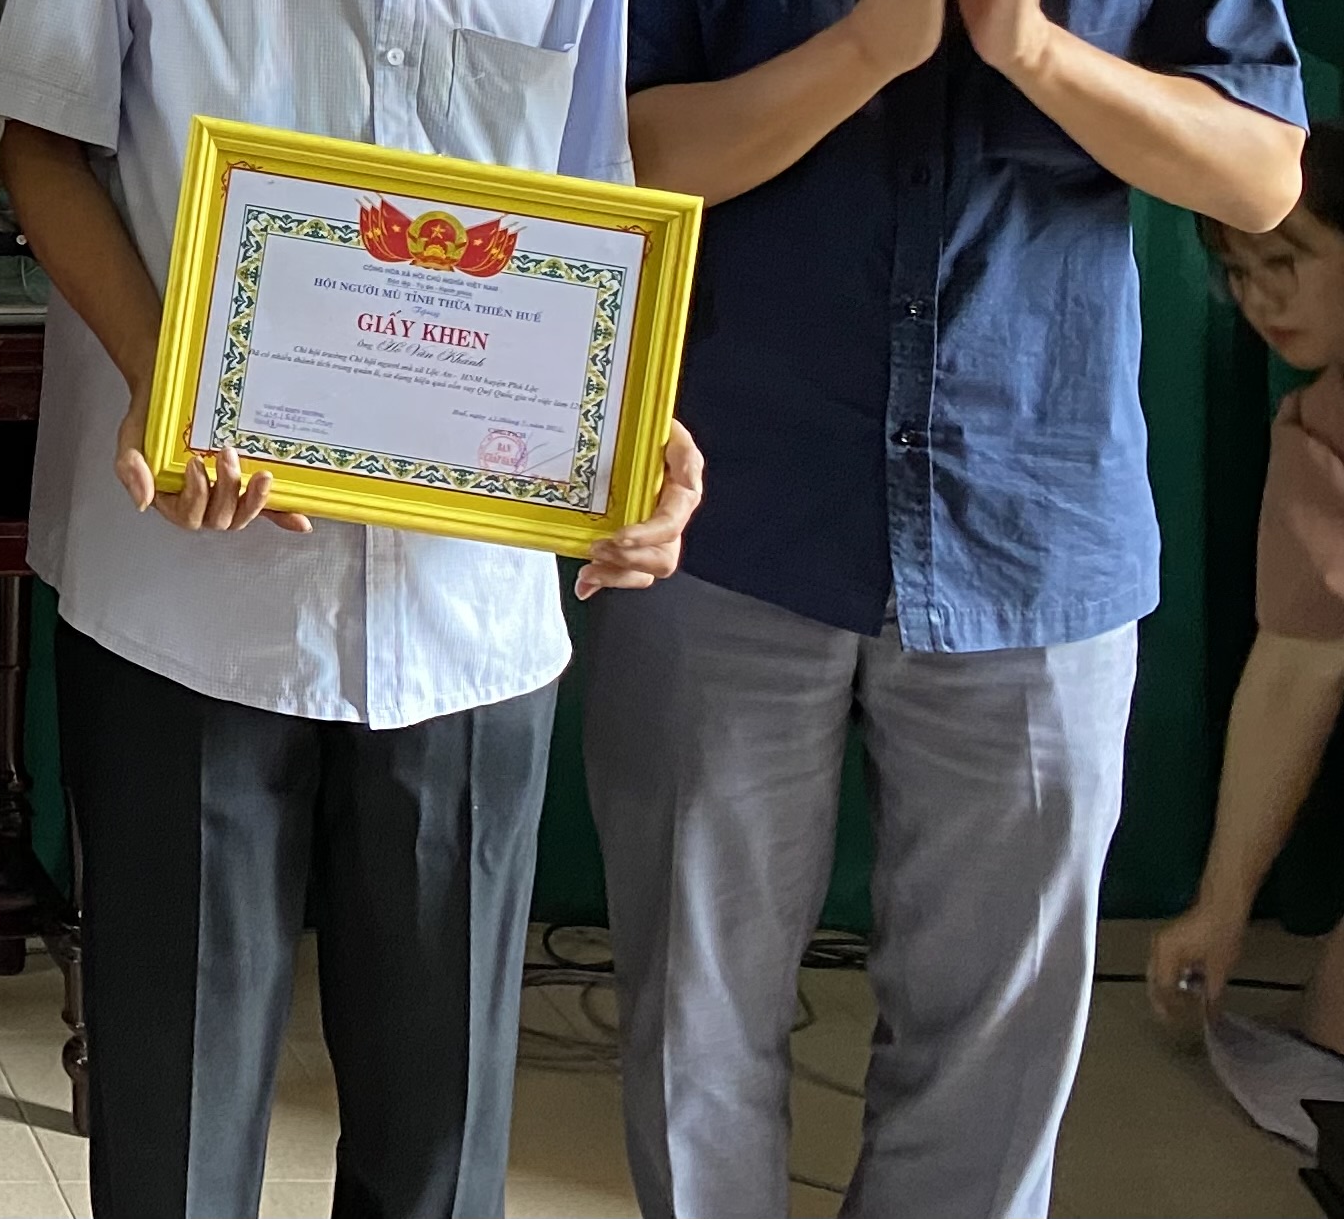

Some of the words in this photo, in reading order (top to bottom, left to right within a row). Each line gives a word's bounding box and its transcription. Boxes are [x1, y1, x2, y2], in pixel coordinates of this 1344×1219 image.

[314, 278, 336, 289] HỘI
[340, 282, 379, 296] NGƯỜI
[382, 289, 400, 299] MÙ
[475, 304, 512, 317] THIÊN
[358, 310, 415, 338] GIẤY
[422, 323, 488, 349] KHEN
